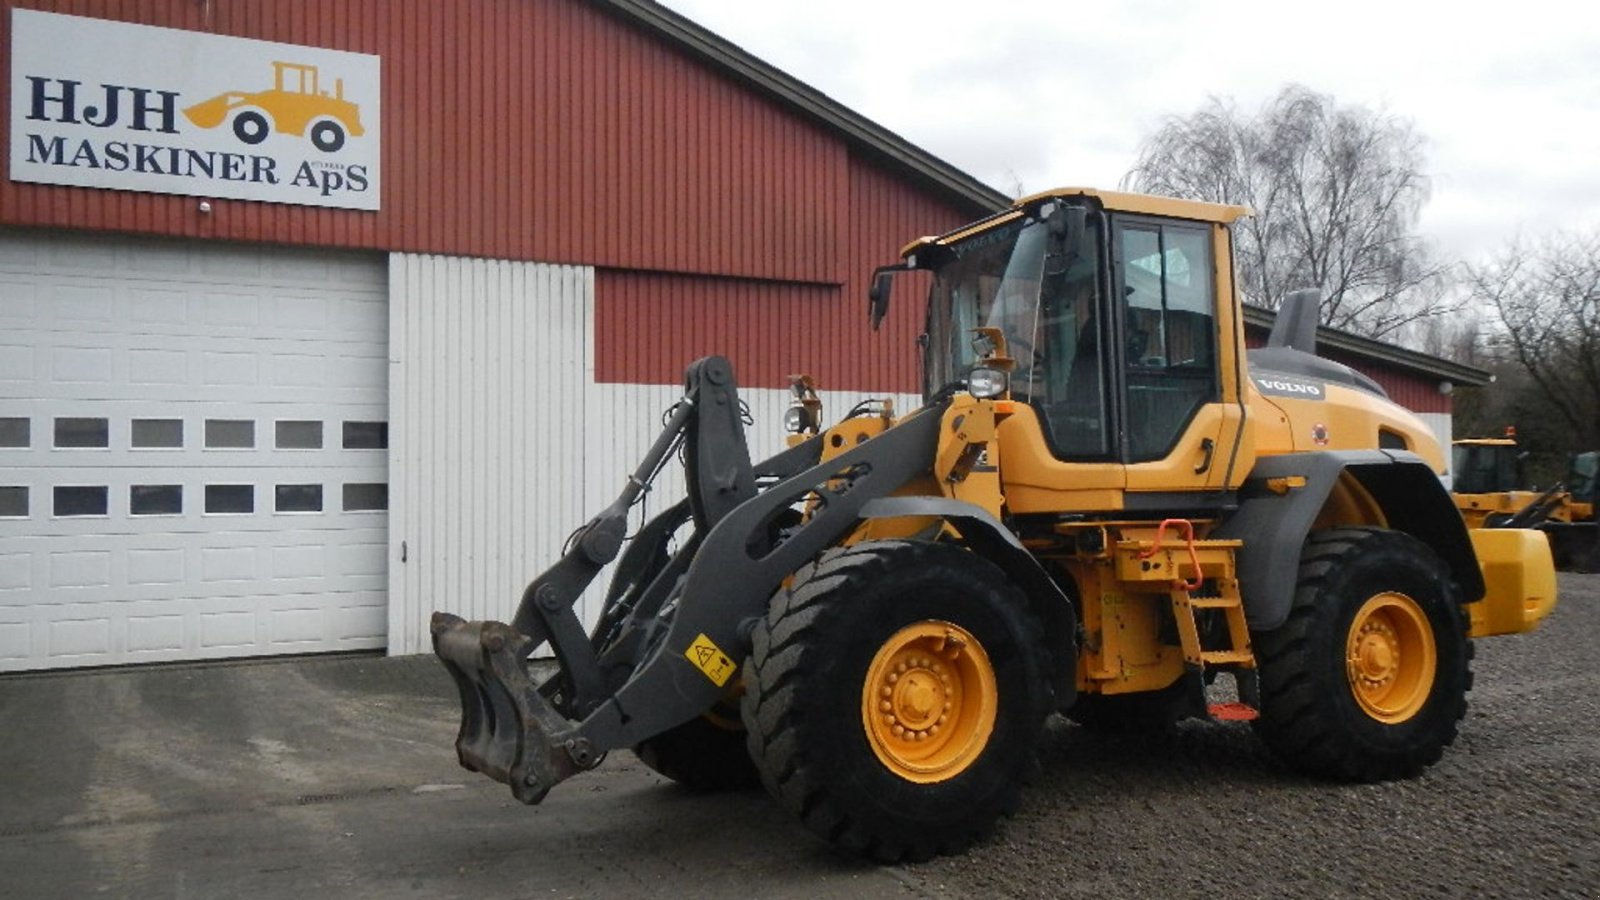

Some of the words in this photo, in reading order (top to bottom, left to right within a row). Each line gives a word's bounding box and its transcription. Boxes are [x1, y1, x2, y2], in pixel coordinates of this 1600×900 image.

[25, 75, 180, 134] HJH
[26, 134, 280, 184] MASKINER
[290, 160, 369, 196] ApS
[1257, 379, 1320, 395] VOLVO
